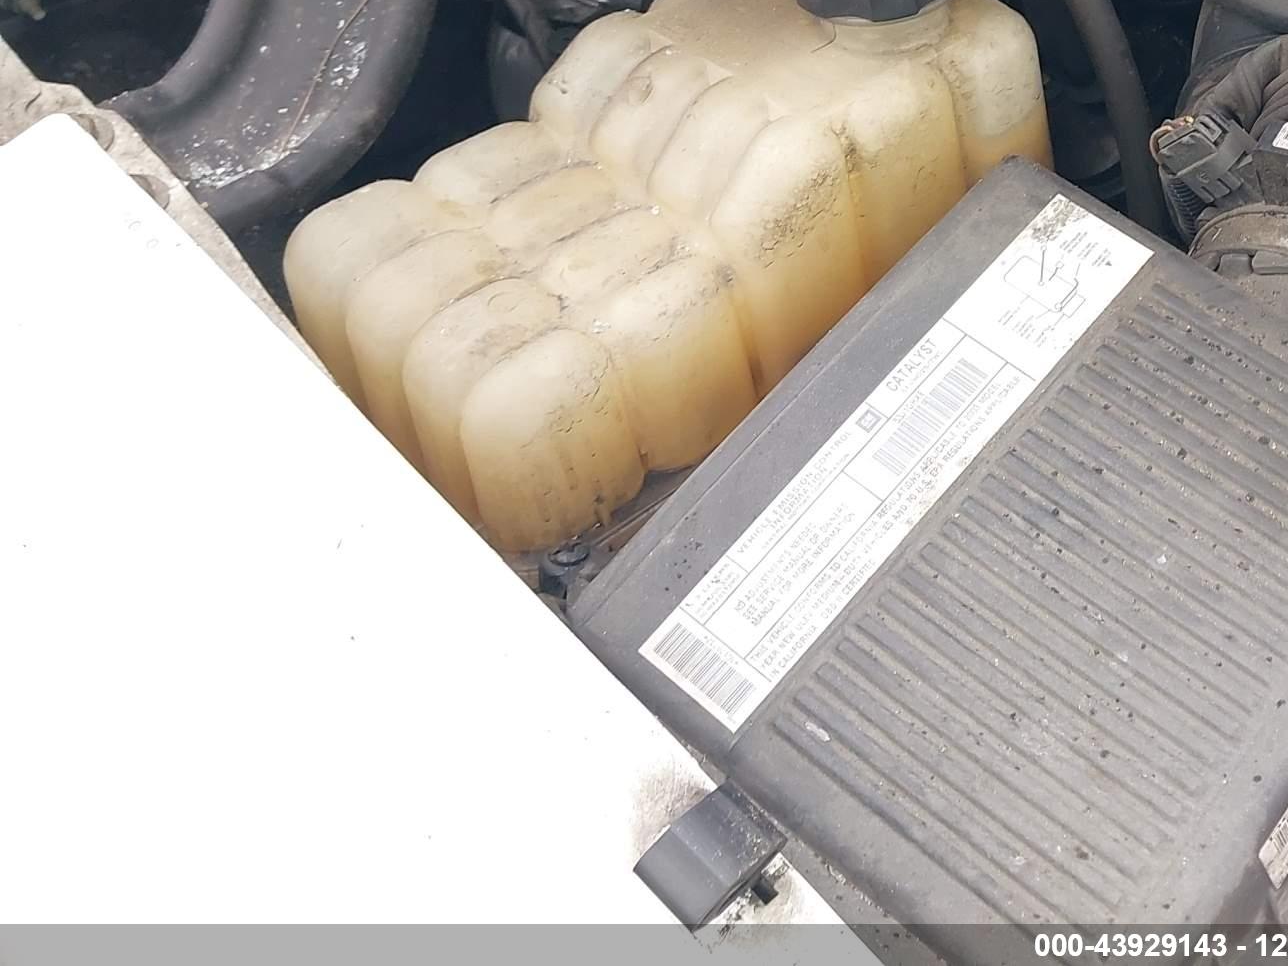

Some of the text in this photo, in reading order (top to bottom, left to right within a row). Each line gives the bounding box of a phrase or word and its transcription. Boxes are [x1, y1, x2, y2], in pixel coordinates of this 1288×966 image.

[884, 337, 939, 393] CATALYST
[928, 461, 945, 477] EPA
[941, 414, 986, 463] REGULATIONS
[735, 429, 852, 555] VEHICLE EMISSION CONTROL
[768, 465, 828, 529] INFORMATION
[765, 612, 796, 645] VEHICLE
[837, 518, 879, 562] CALIFORNIA
[875, 470, 922, 520] REGULATIONS
